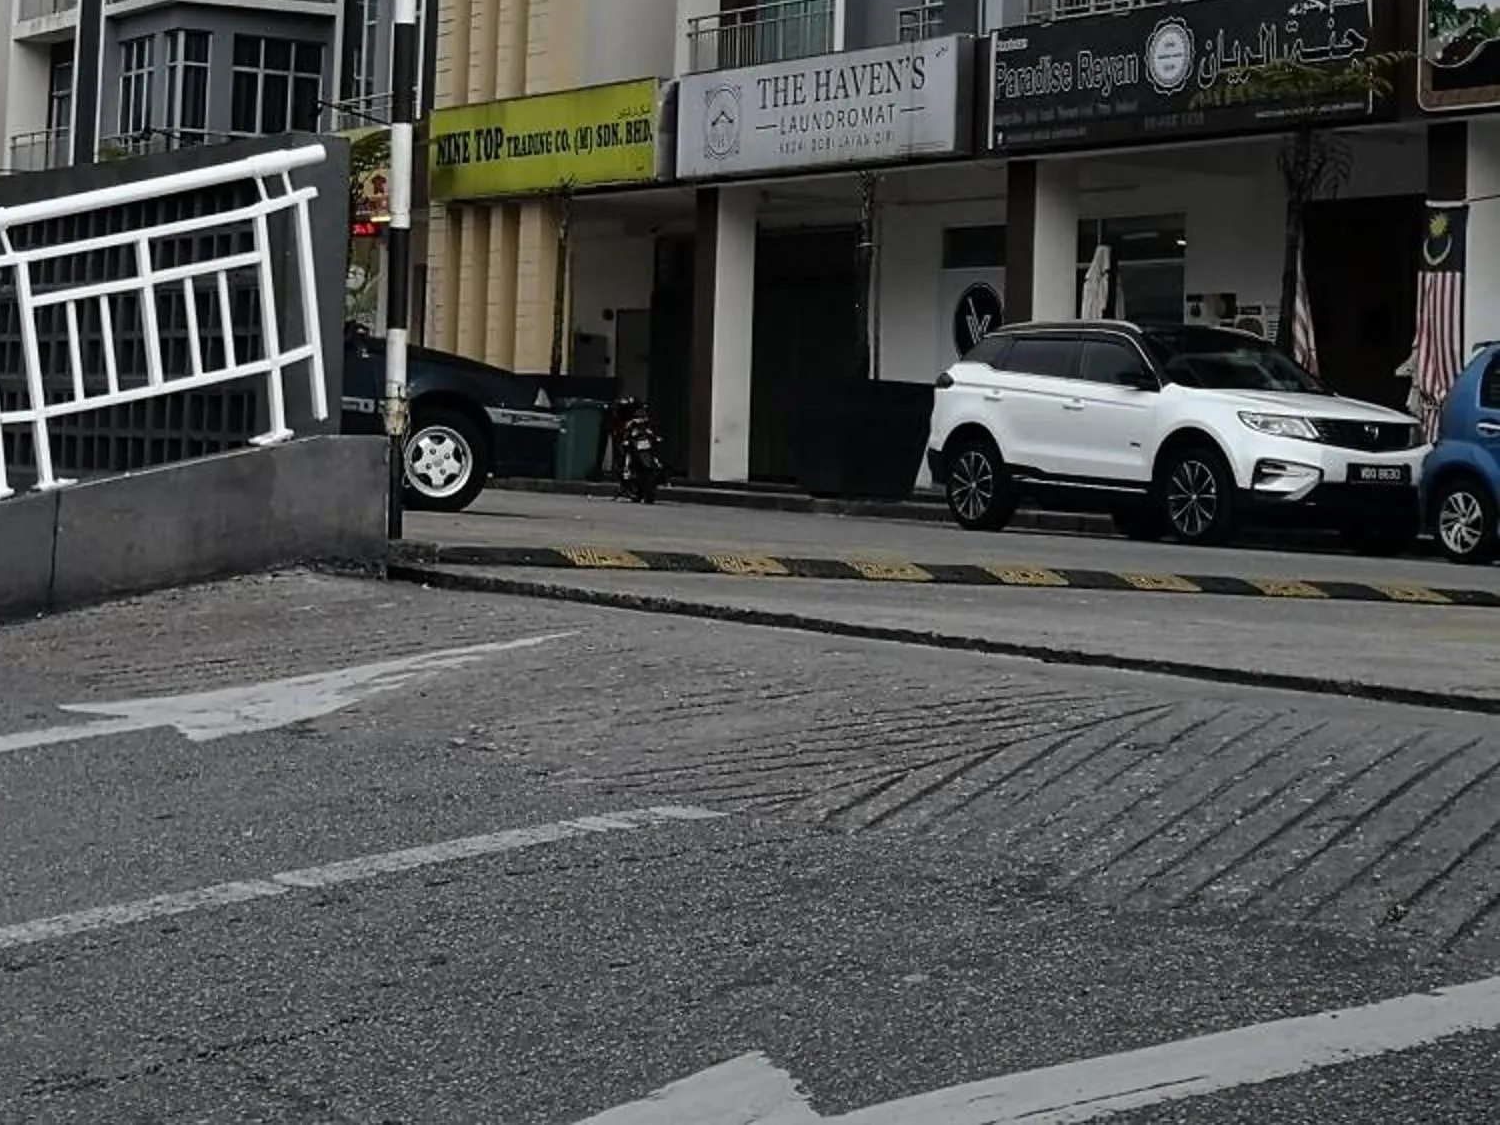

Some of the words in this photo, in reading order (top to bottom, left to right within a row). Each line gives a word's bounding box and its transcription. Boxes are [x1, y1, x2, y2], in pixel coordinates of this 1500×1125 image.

[757, 72, 807, 109] THE
[813, 56, 926, 102] HAVEN'S
[995, 55, 1073, 99] Paradise
[1077, 50, 1139, 97] Reyan
[436, 130, 471, 166] NINE
[474, 126, 504, 162] TOP
[506, 130, 552, 158] TRADING
[574, 126, 594, 155] (M)
[597, 121, 622, 147] SDN.
[626, 118, 653, 144] BHD.
[779, 103, 897, 135] LAUNDROMAT
